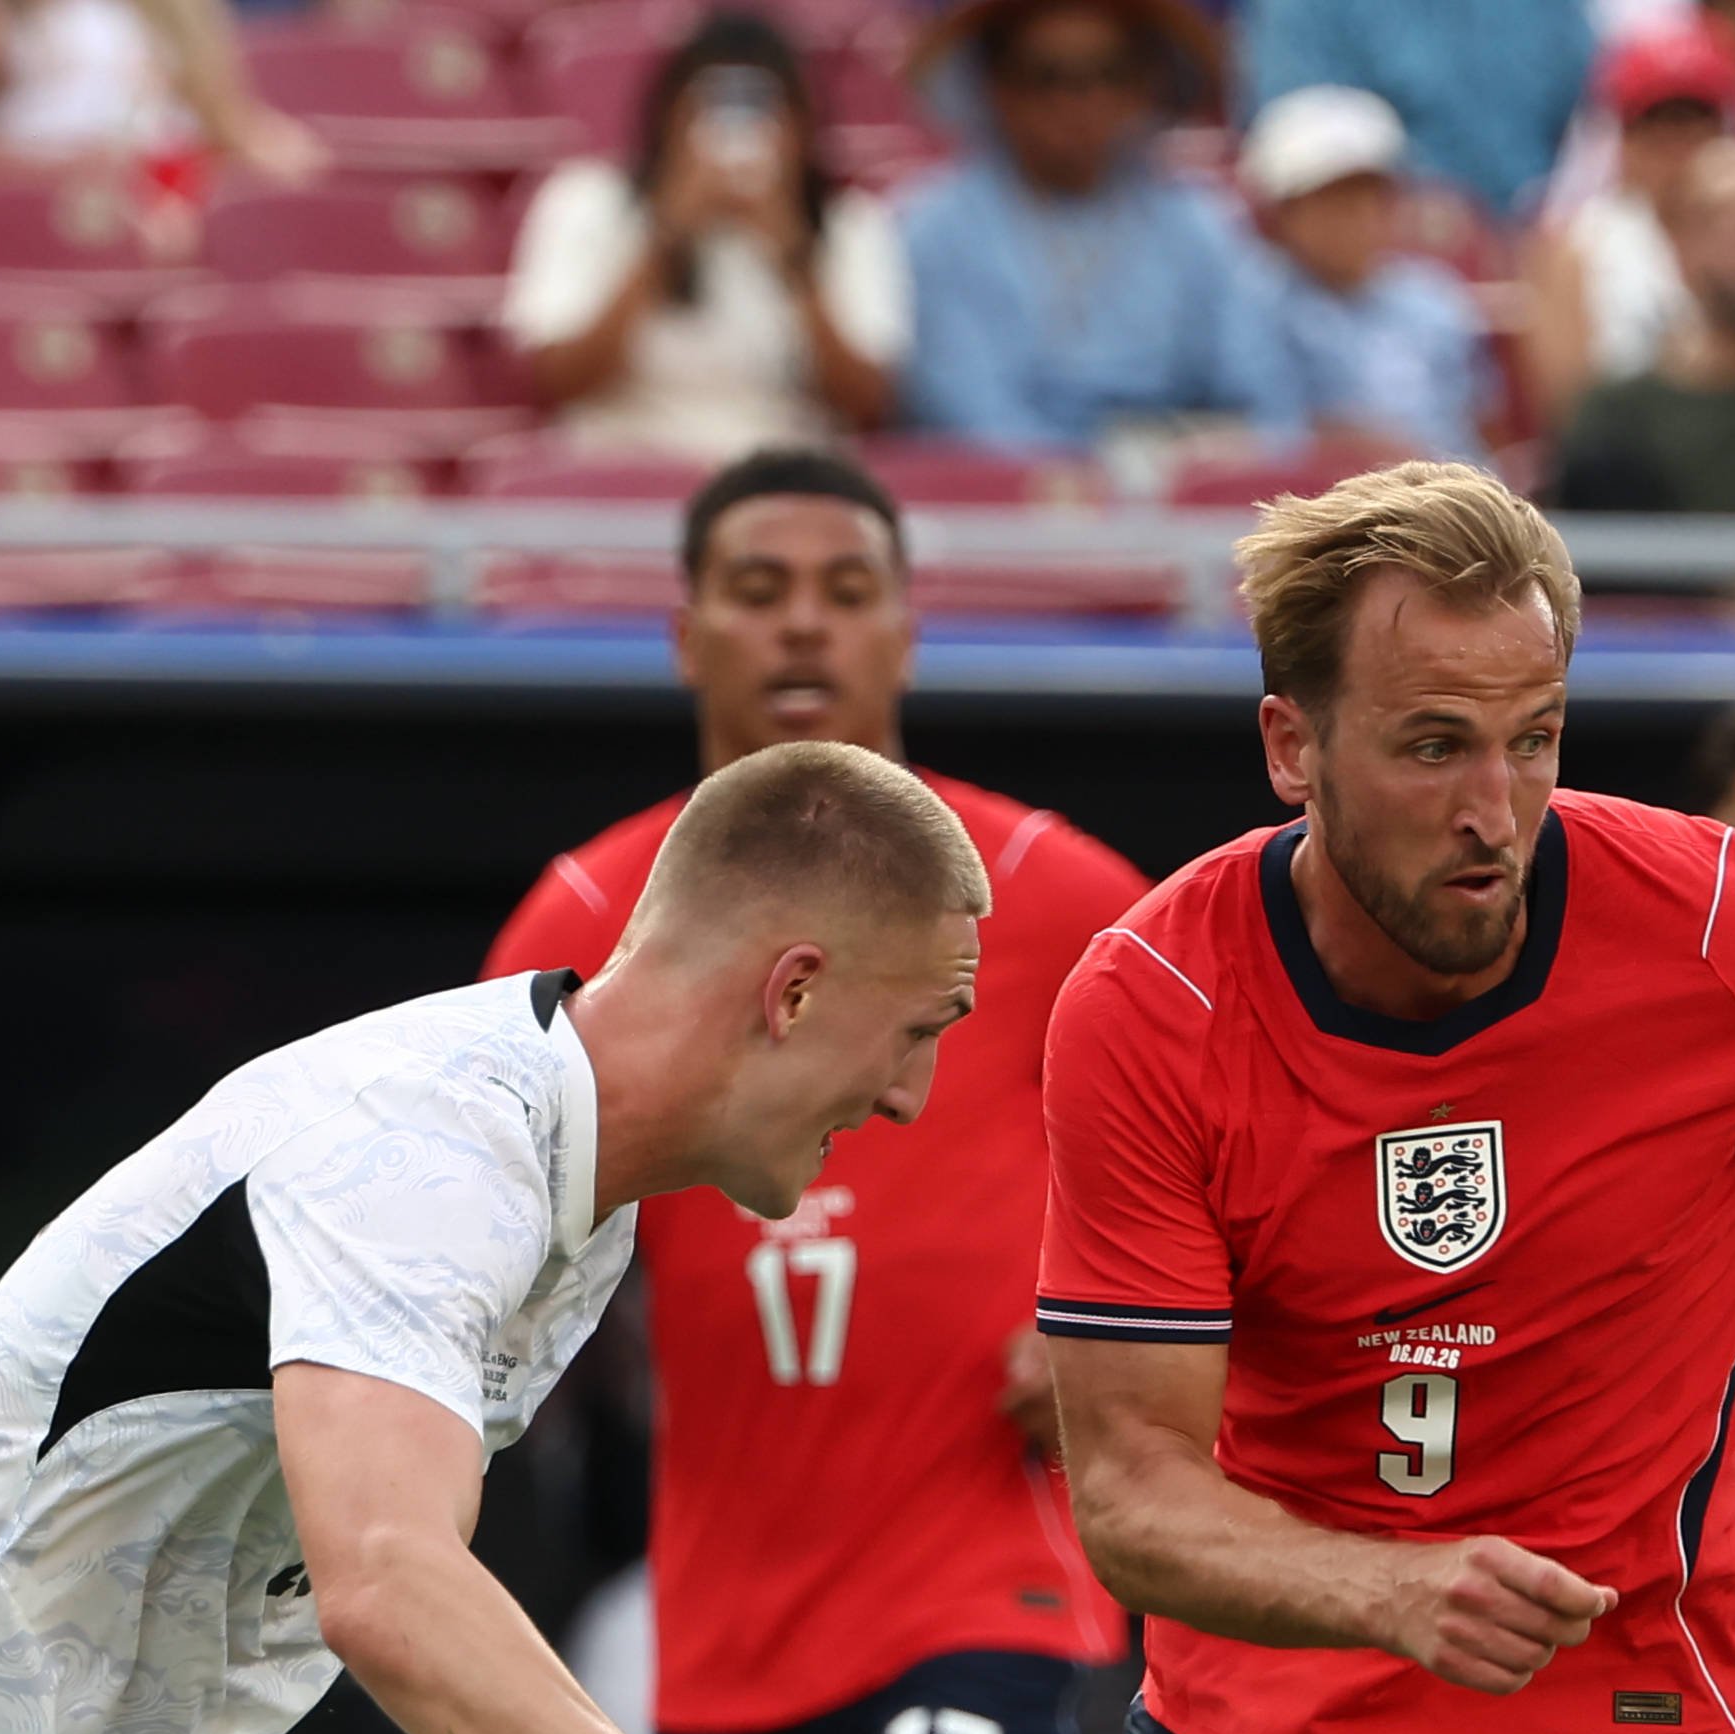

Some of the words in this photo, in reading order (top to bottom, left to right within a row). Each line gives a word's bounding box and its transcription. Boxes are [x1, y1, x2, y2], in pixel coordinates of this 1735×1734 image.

[745, 1234, 857, 1387] 17
[1358, 1330, 1400, 1347] NEW
[1406, 1324, 1496, 1345] ZEALAND
[1389, 1344, 1460, 1369] 06.06.26
[1378, 1372, 1459, 1497] 9
